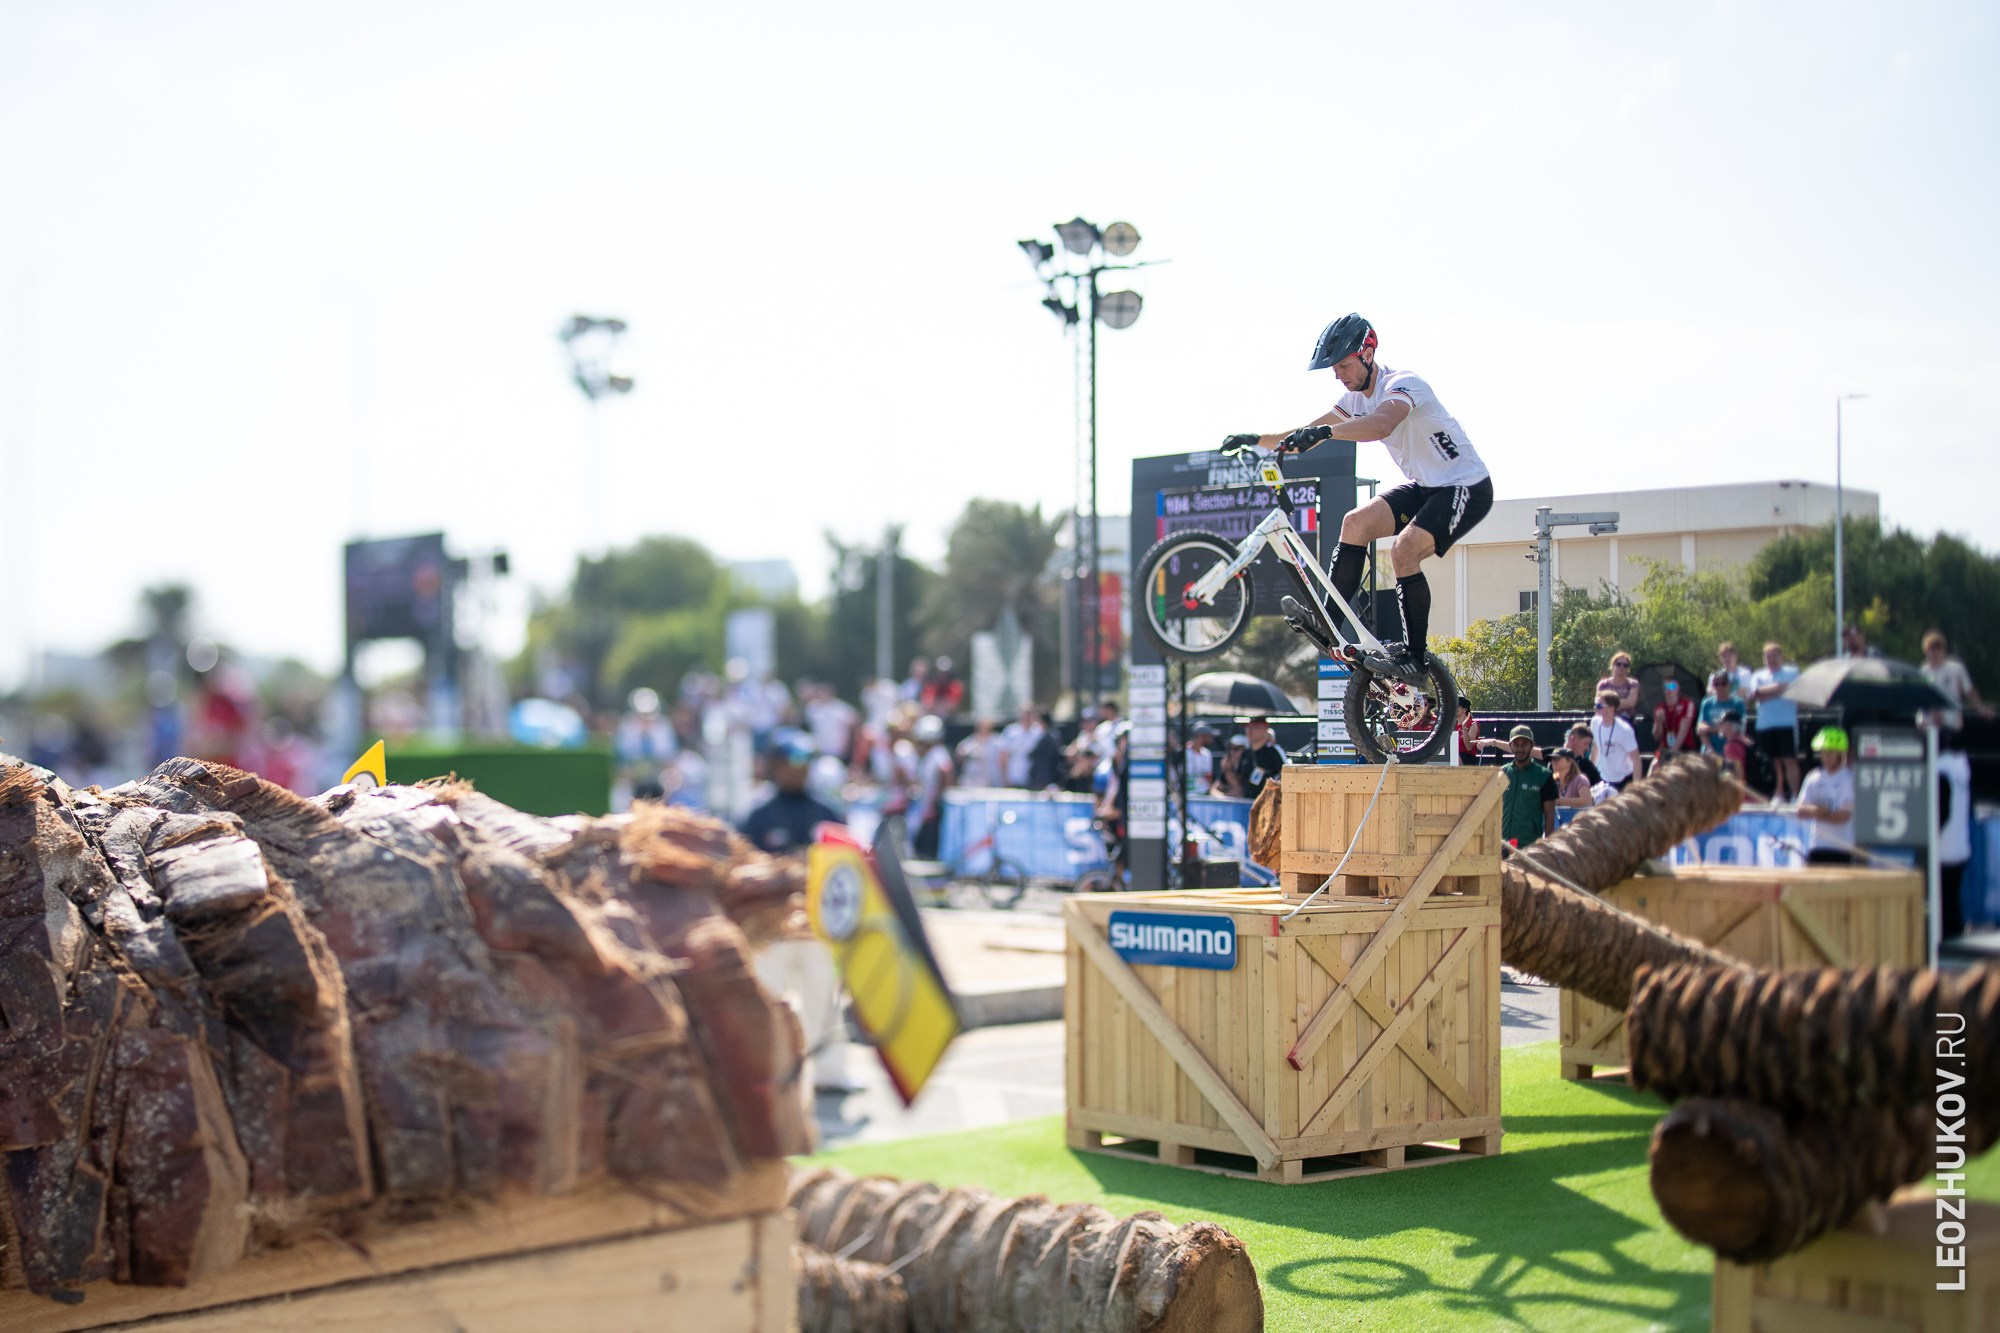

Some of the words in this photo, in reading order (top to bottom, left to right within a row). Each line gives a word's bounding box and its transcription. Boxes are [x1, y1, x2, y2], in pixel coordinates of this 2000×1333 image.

[1433, 431, 1460, 460] KTM
[1859, 767, 1923, 789] START
[1875, 790, 1909, 842] 5
[1110, 922, 1232, 956] SHIMANO
